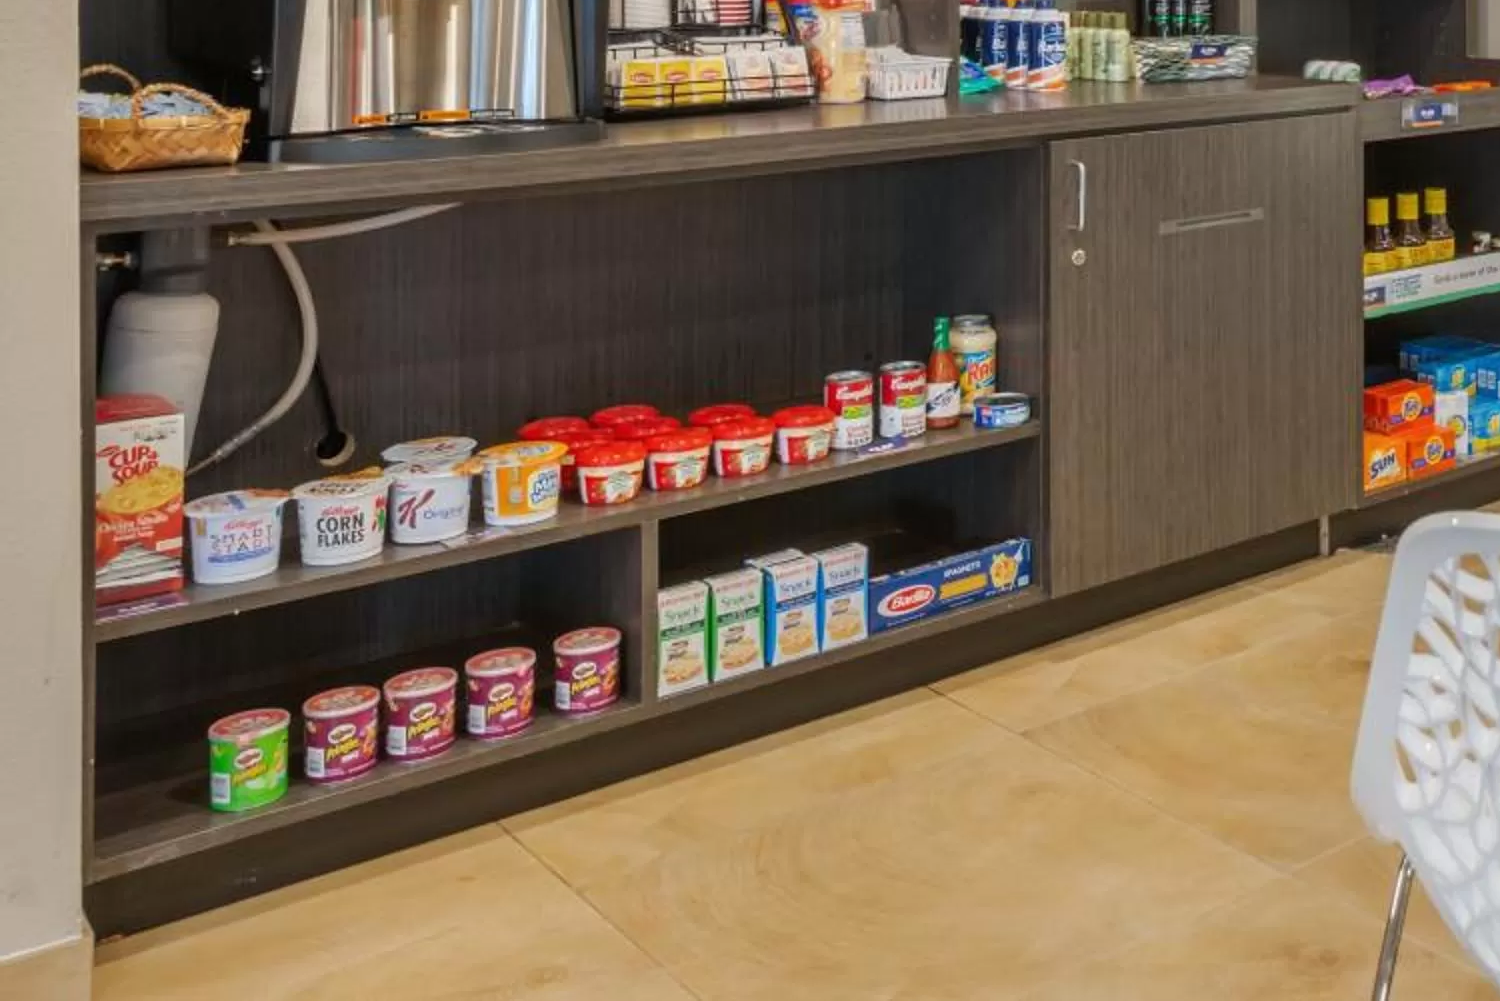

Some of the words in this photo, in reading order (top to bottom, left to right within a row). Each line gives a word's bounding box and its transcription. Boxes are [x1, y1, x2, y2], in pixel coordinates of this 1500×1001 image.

[108, 445, 151, 469] CUP
[1370, 452, 1395, 480] SUN
[112, 459, 159, 486] SOUP
[397, 488, 436, 530] K
[316, 512, 365, 534] CORN
[316, 528, 365, 548] FLAKES
